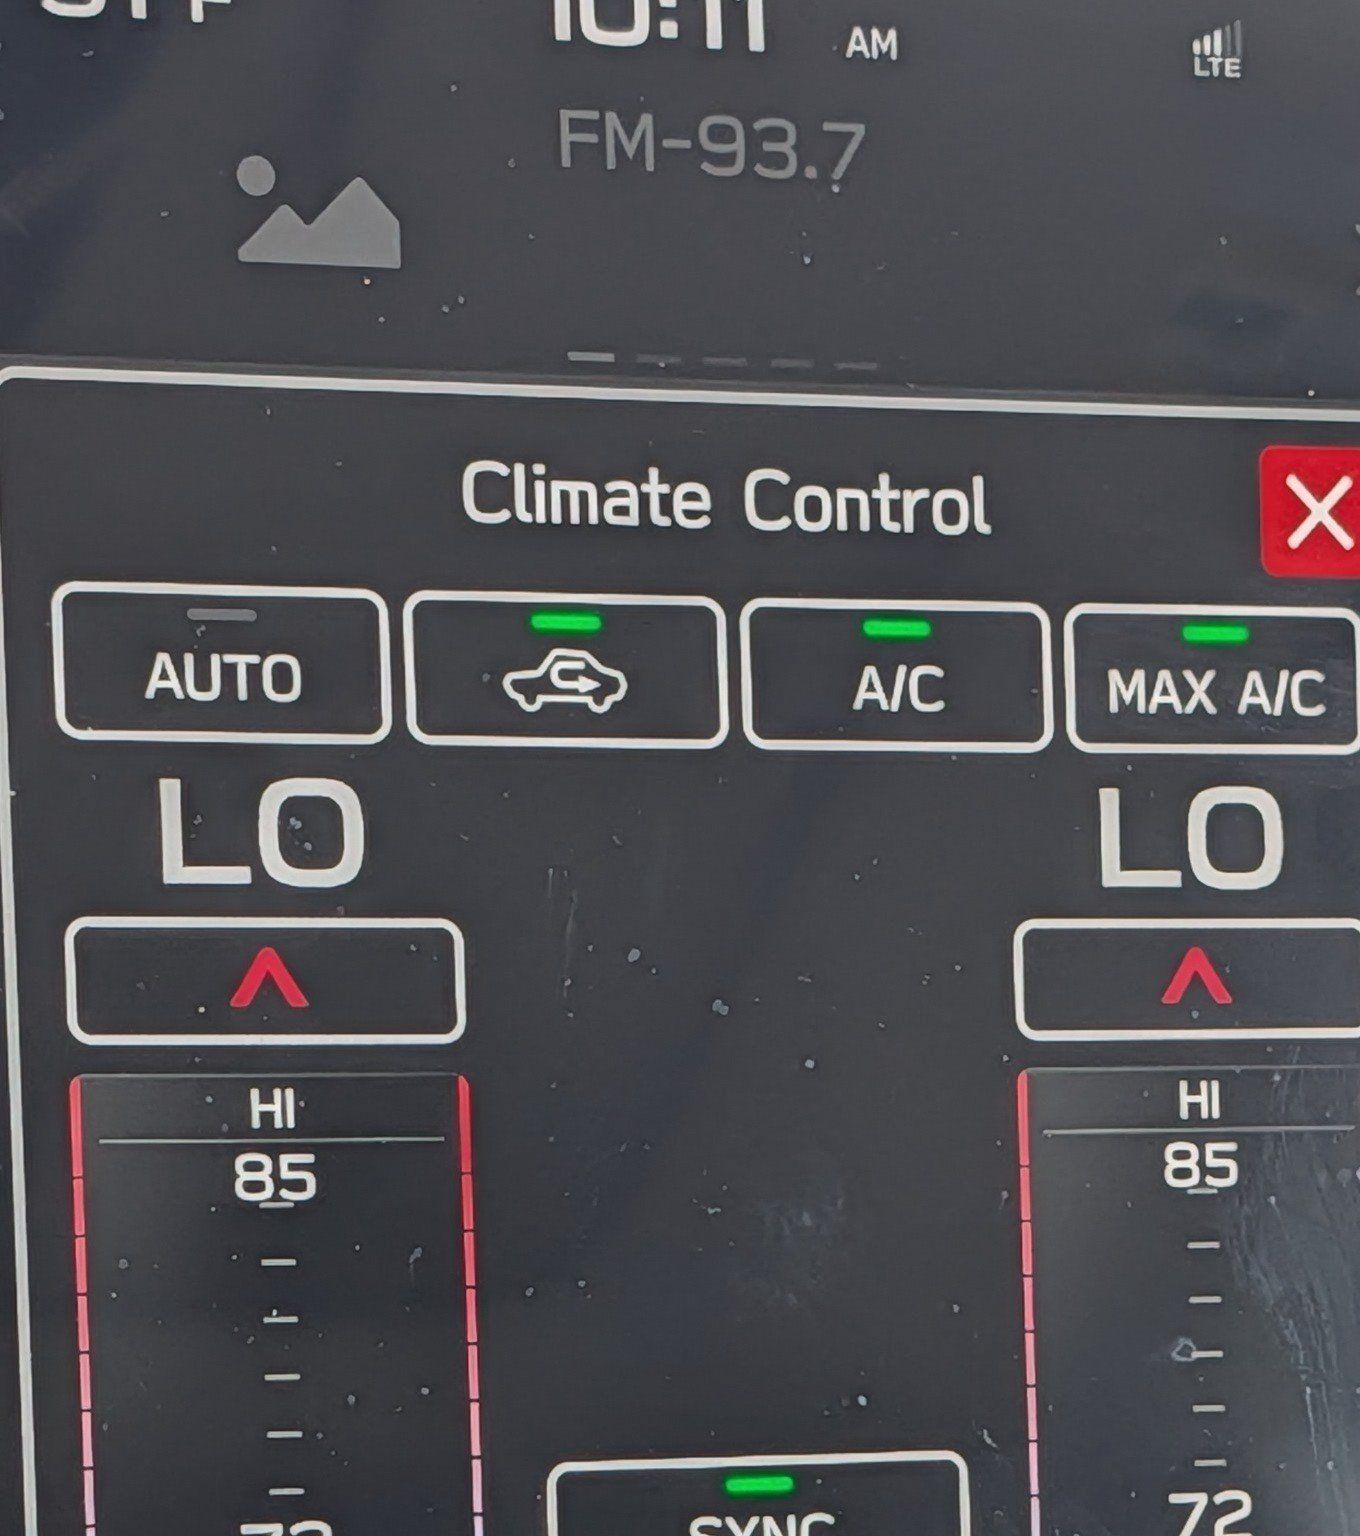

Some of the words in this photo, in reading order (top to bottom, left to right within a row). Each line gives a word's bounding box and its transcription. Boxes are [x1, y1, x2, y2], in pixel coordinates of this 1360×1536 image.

[845, 26, 898, 61] AM
[1194, 56, 1241, 78] LTE
[559, 108, 866, 180] FM-93.7
[462, 459, 712, 529] Climate
[744, 468, 992, 536] Control
[144, 652, 302, 703] AUTO
[852, 664, 945, 713] A/C
[1107, 668, 1218, 715] MAX
[1237, 669, 1326, 717] A/C
[158, 777, 365, 888] LO
[1098, 785, 1284, 891] LO
[250, 1087, 296, 1129] HI
[1179, 1080, 1221, 1120] HI
[234, 1152, 317, 1202] 85
[1164, 1141, 1239, 1188] 85
